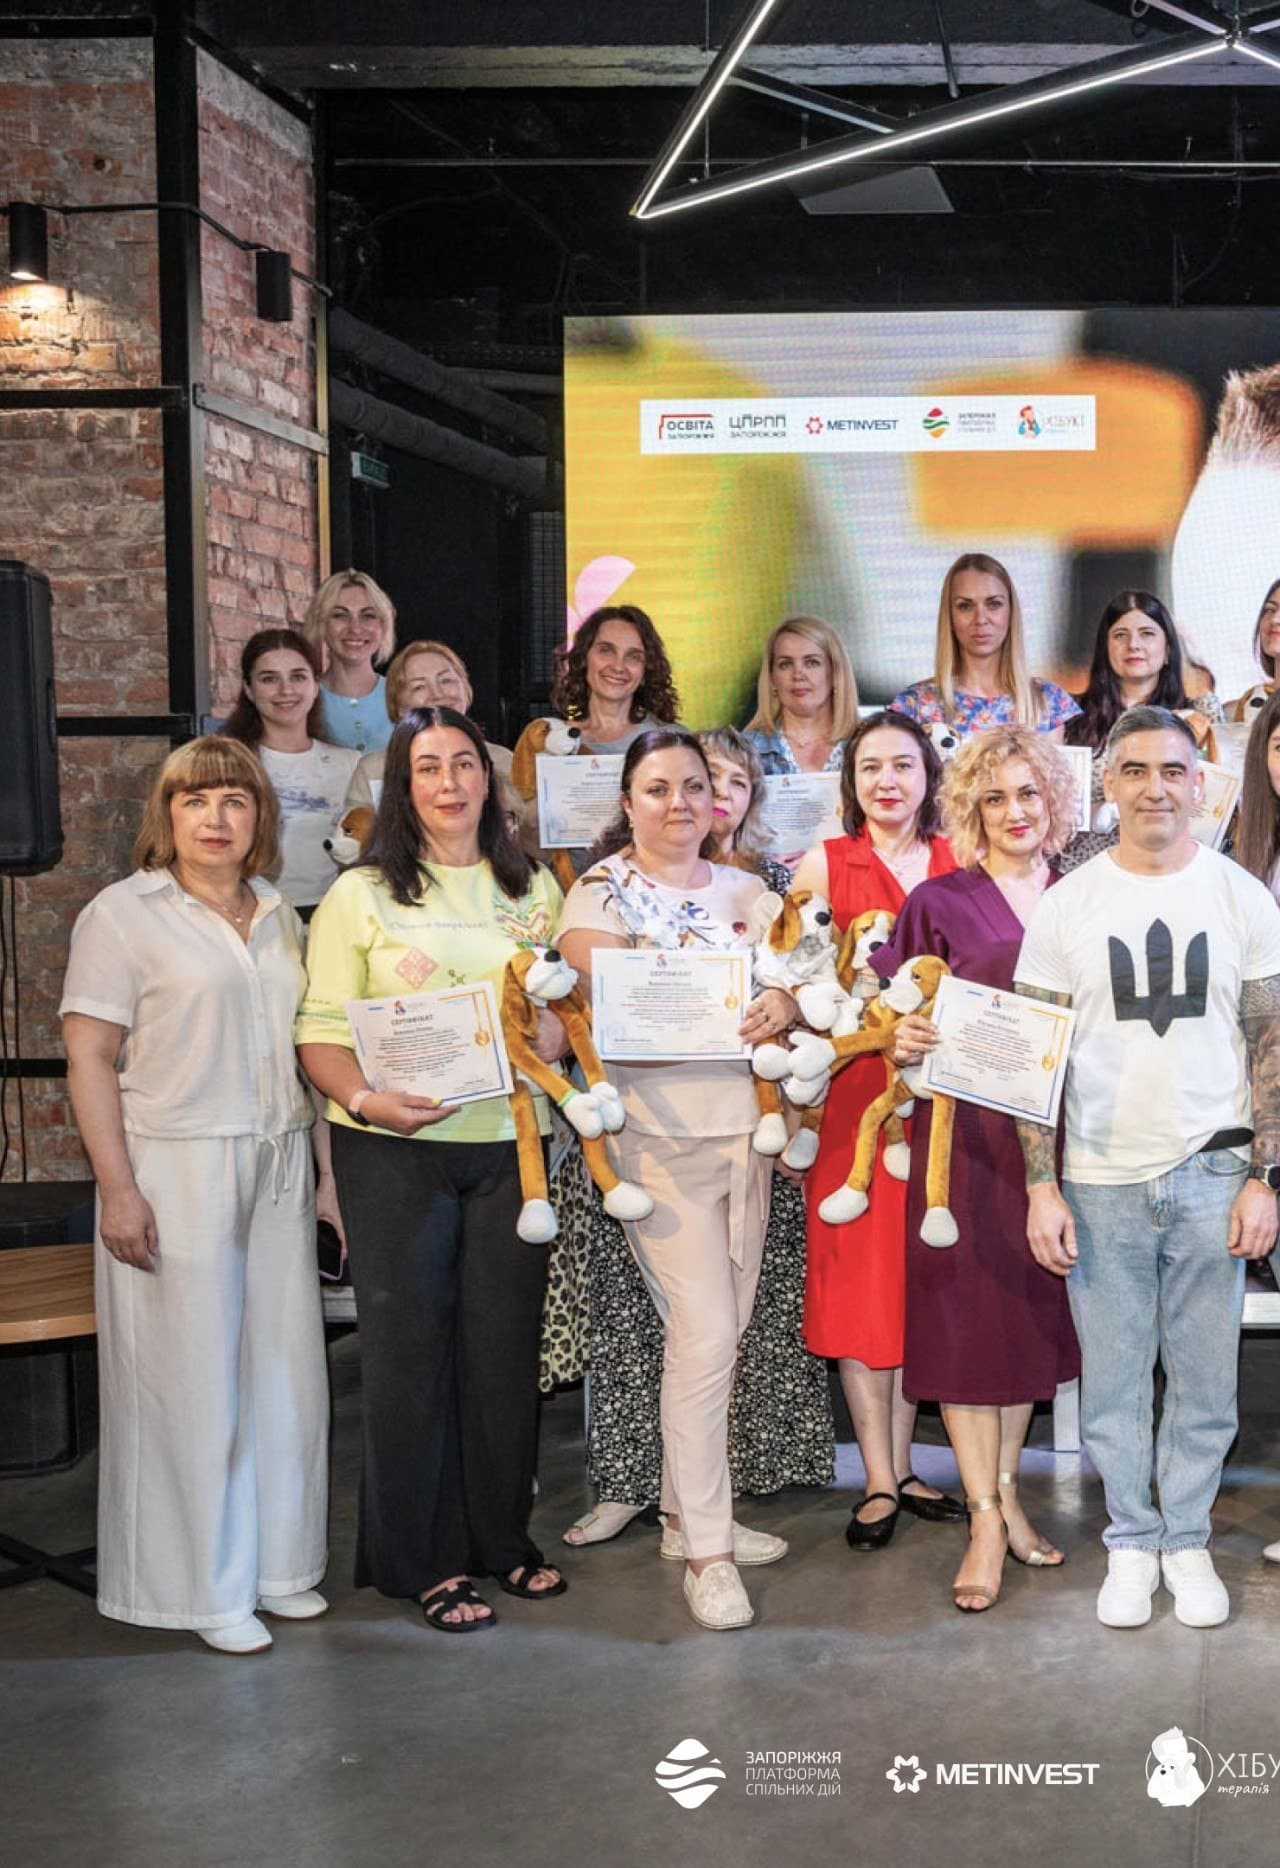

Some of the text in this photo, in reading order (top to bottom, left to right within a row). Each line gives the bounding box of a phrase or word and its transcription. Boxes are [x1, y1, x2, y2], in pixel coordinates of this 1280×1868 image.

[666, 419, 714, 431] ОСВІТА
[729, 413, 787, 430] ЦПРПП
[827, 418, 900, 431] METINVEST
